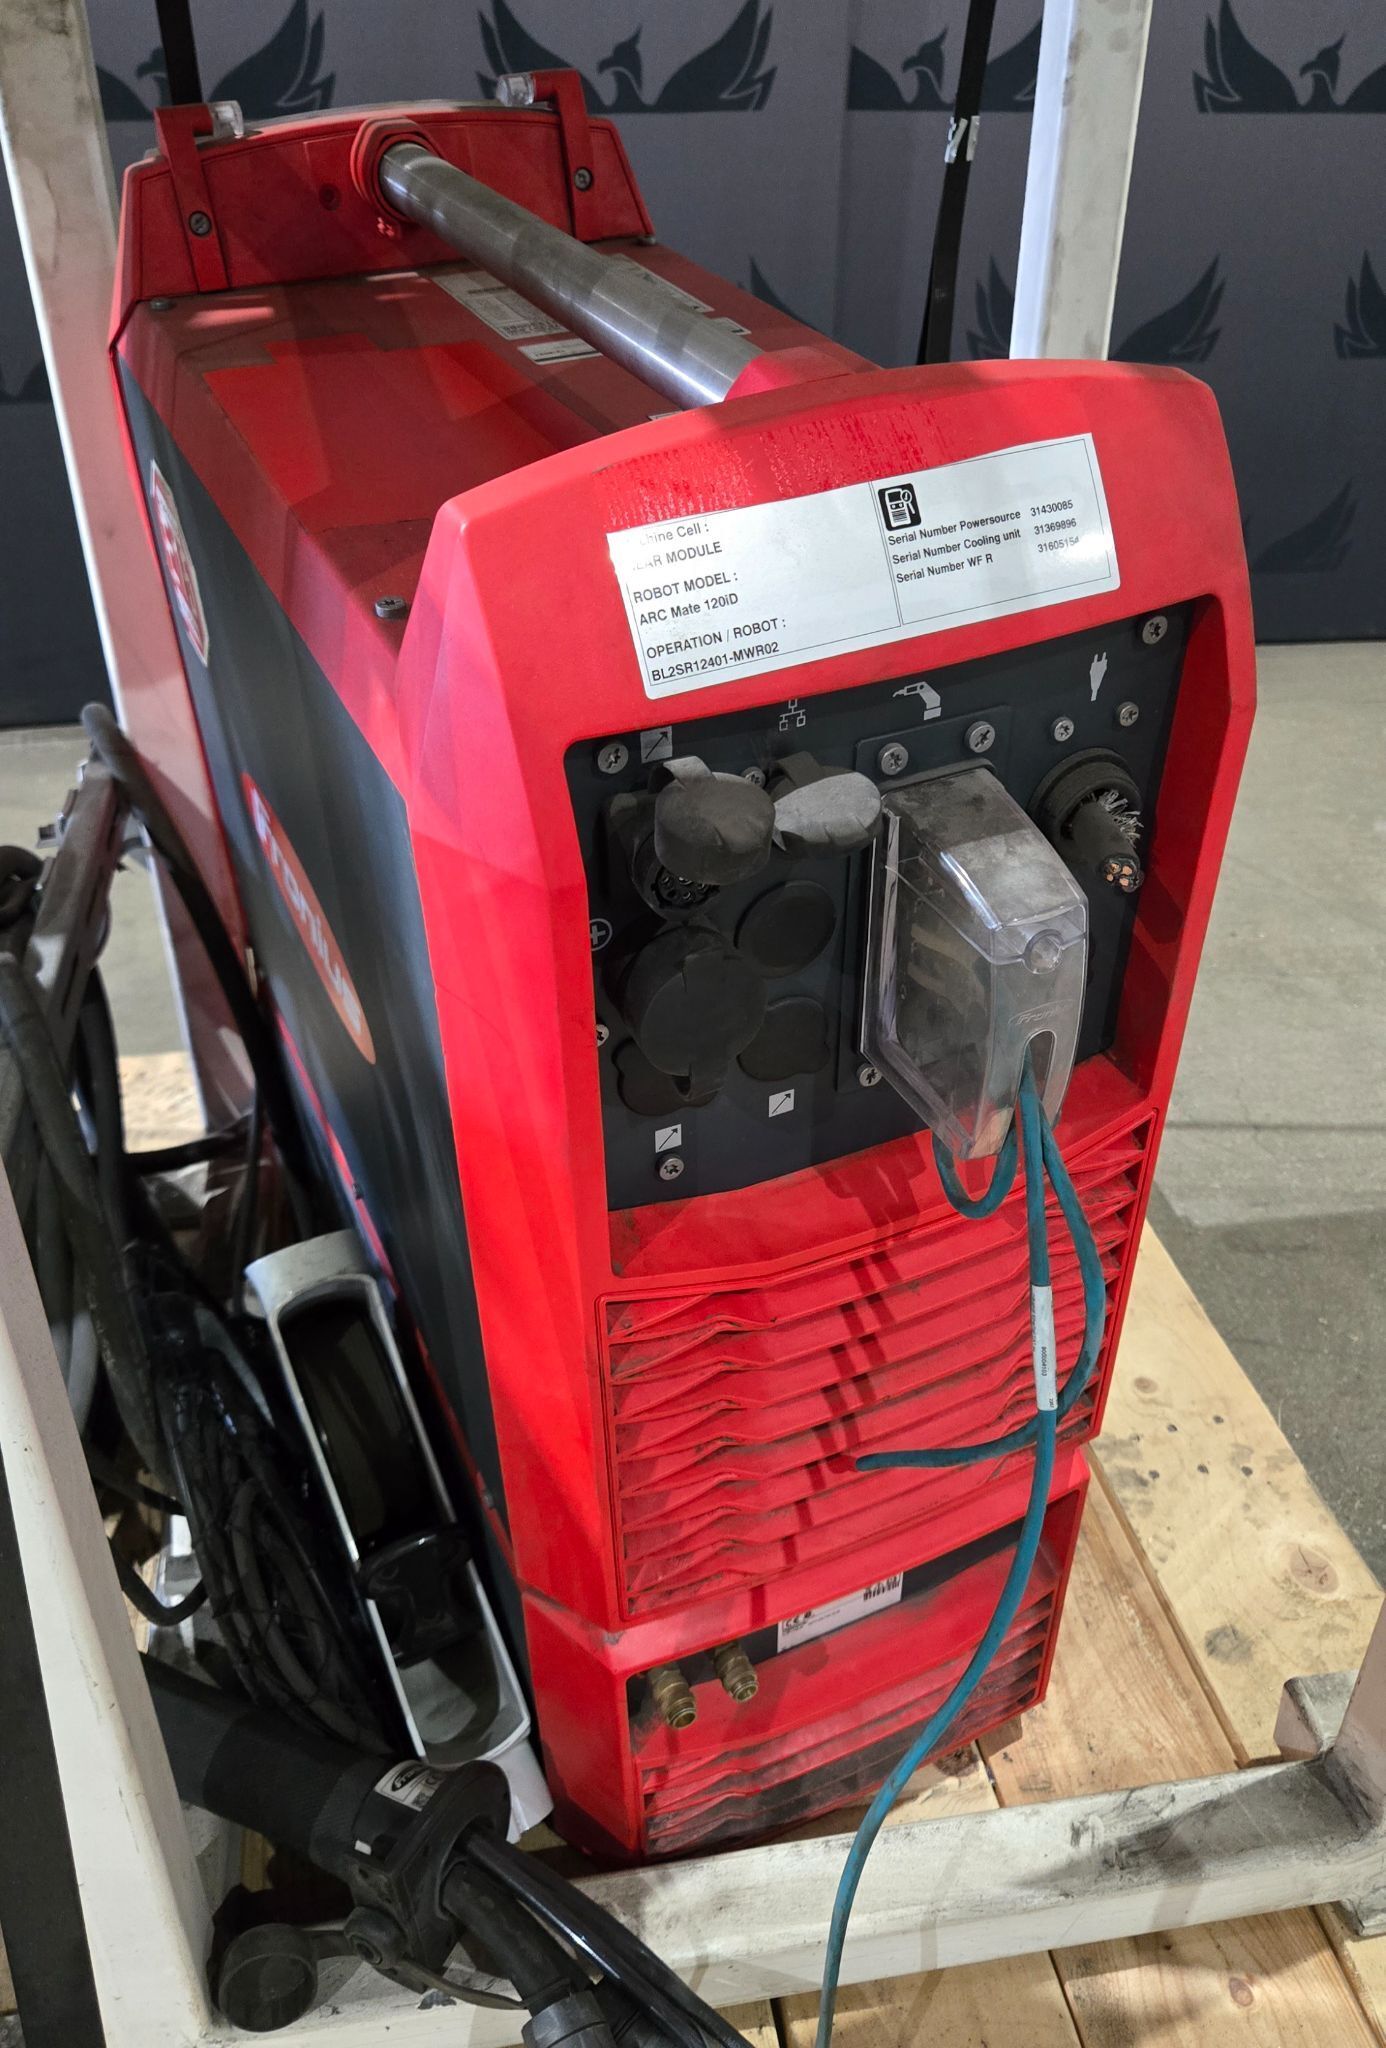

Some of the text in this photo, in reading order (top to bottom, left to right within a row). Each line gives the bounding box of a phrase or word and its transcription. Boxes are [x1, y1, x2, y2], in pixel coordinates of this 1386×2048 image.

[677, 523, 702, 538] Cell
[888, 500, 1074, 546] Serial Number Powersource 31430085
[666, 541, 722, 564] MODULE
[892, 518, 1077, 565] Serial Number Cooling unit 31369896
[896, 568, 925, 584] Serial
[927, 561, 965, 577] Number
[967, 555, 983, 568] WF
[985, 553, 994, 564] R
[633, 583, 680, 603] ROBOT
[684, 572, 731, 592] MODEL
[640, 593, 739, 626] ARC Mate 120iD
[647, 631, 723, 659] OPERATION
[733, 618, 779, 639] ROBOT
[651, 642, 780, 681] BL2SR12401-MWR02
